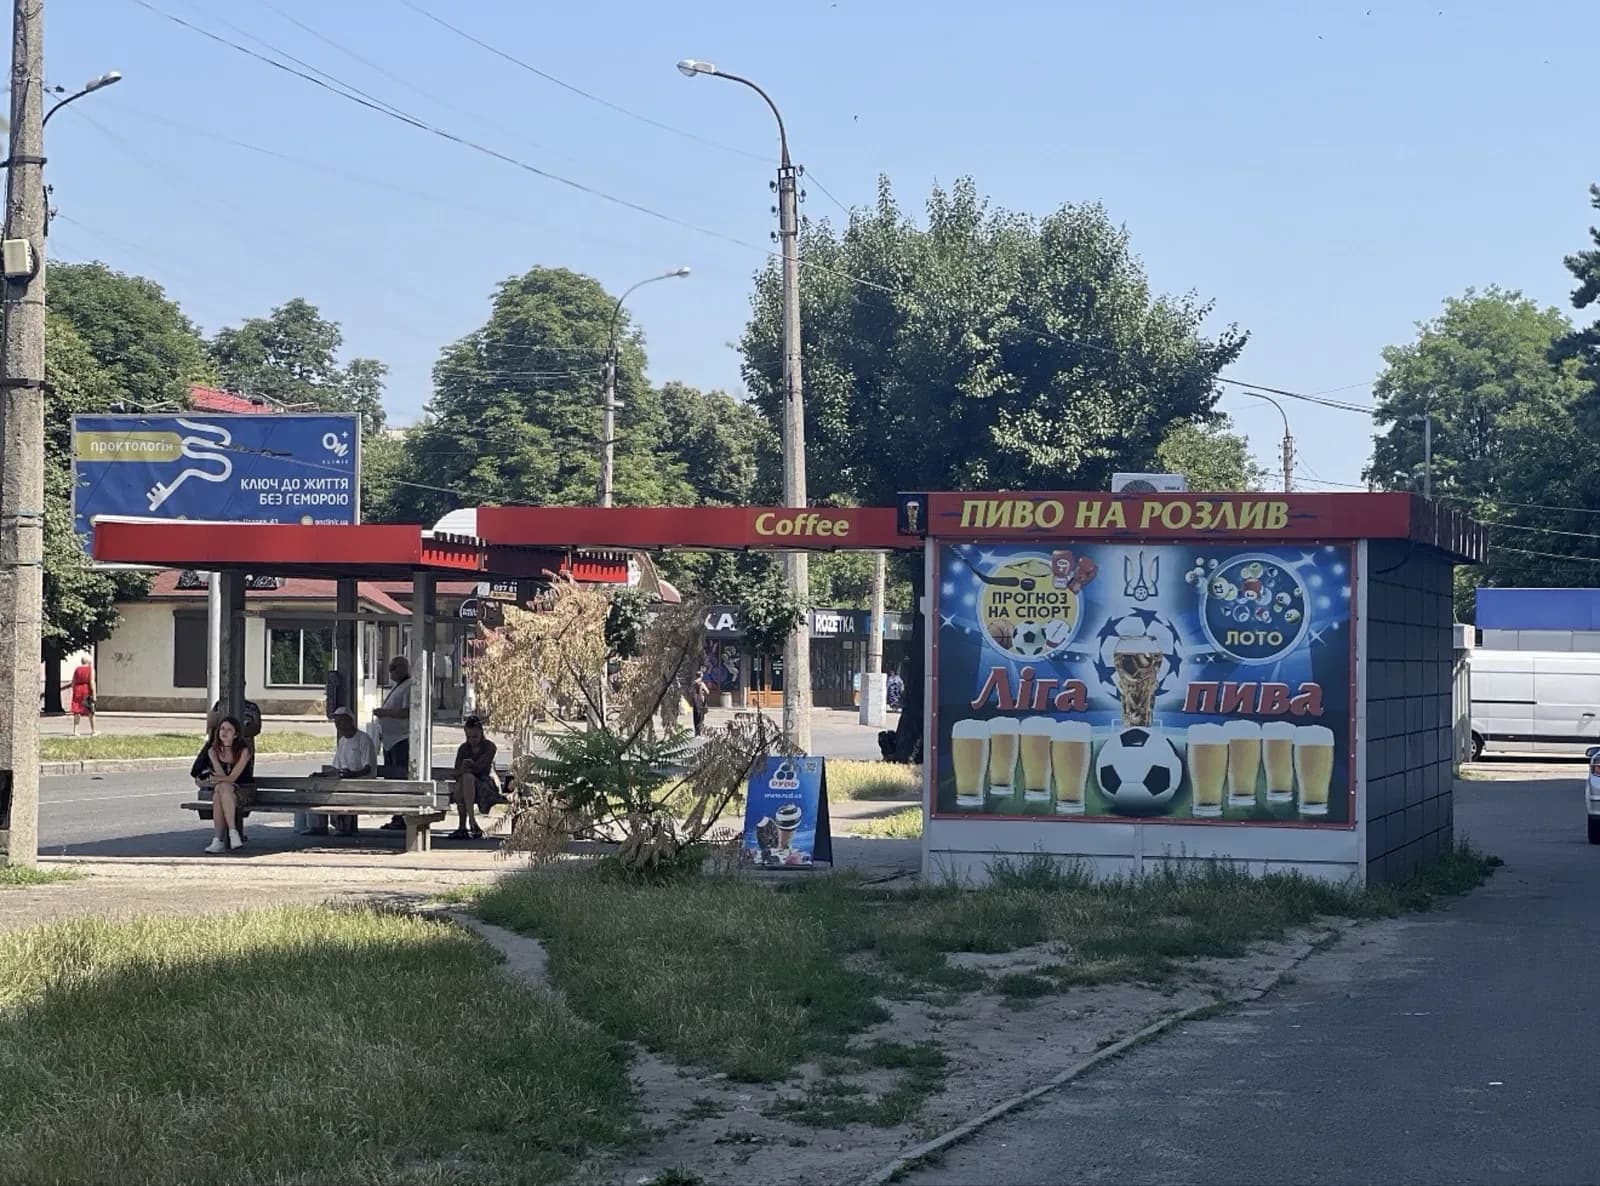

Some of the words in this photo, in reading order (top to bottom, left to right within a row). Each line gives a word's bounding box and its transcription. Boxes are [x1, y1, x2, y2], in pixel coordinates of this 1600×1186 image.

[90, 441, 174, 454] проктологія
[240, 479, 278, 491] КЛЮЧ
[281, 478, 301, 492] ДО
[304, 478, 349, 491] ЖИТТЯ
[259, 493, 282, 505] БЕЗ
[286, 493, 349, 506] ГЕМОРОЮ
[960, 501, 1064, 527] ПИВО
[1075, 501, 1127, 529] НА
[1140, 502, 1289, 529] РОЗЛИВ
[755, 512, 850, 536] Coffee
[992, 592, 1068, 605] ПРОГНОЗ
[987, 606, 1011, 619] НА
[1015, 605, 1073, 619] СПОРТ
[815, 615, 856, 632] ROZETKA
[1226, 631, 1284, 648] ЛОТО
[971, 667, 1089, 710] Ліга
[1183, 679, 1325, 714] пива
